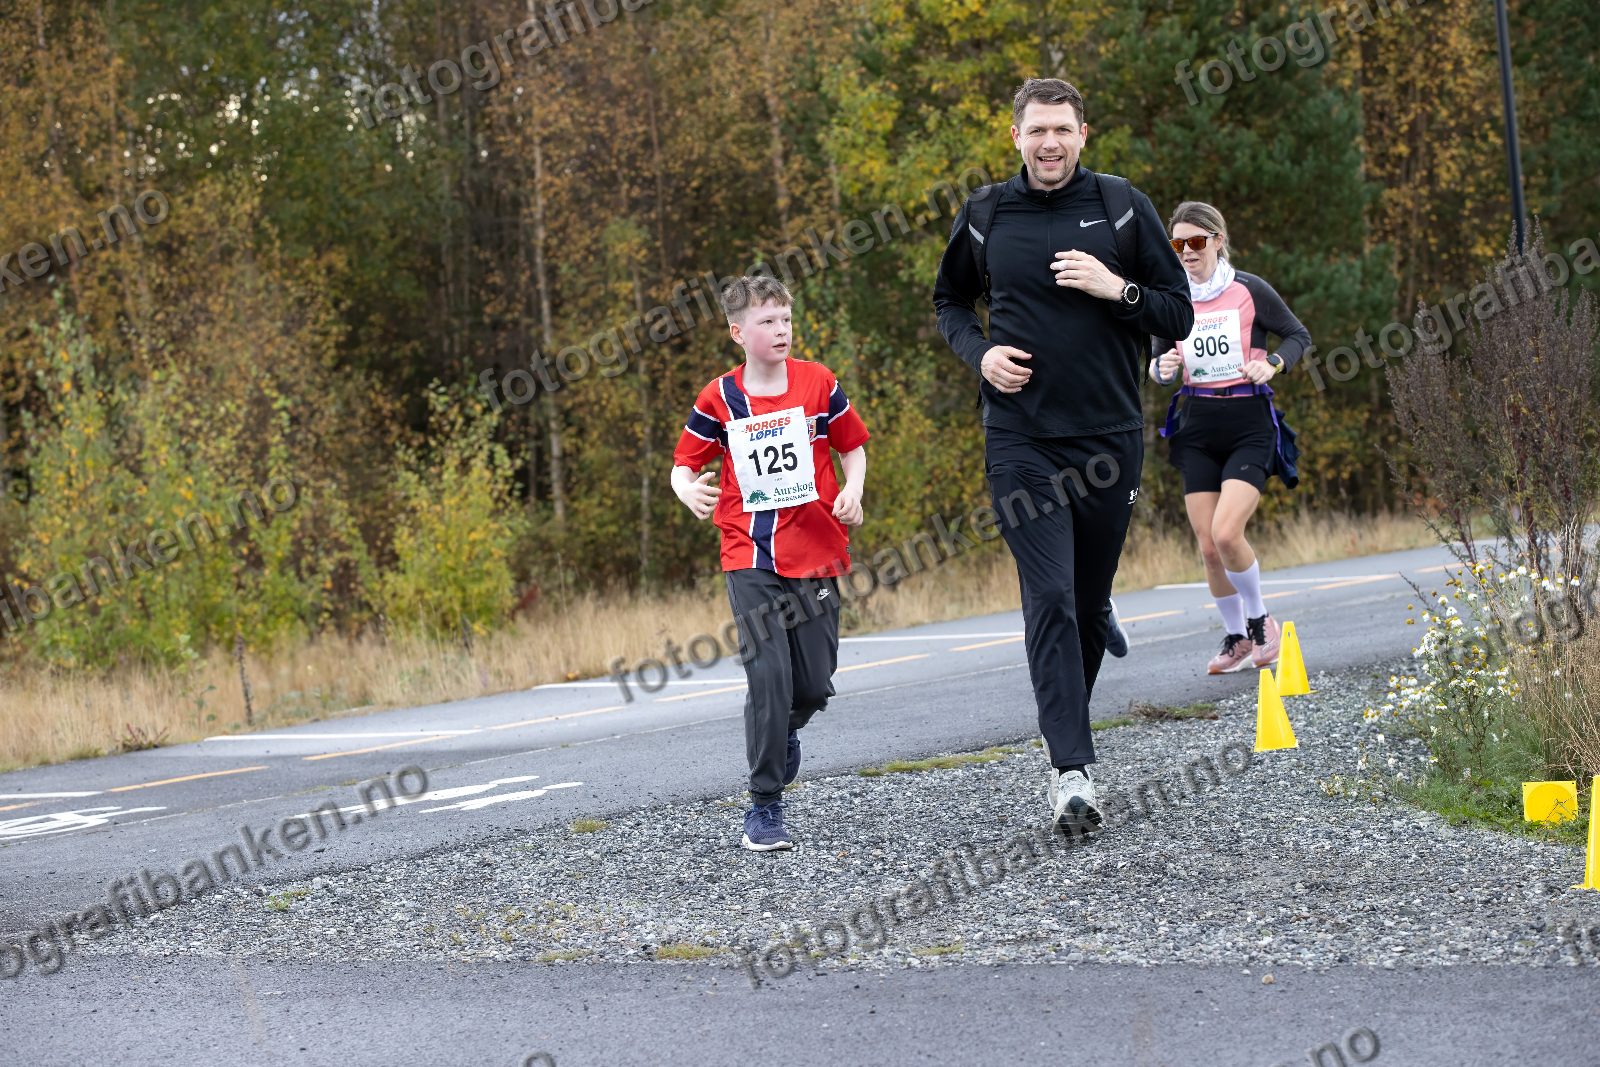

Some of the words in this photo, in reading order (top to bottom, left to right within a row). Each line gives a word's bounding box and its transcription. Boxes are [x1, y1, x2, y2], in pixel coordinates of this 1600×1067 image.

[1194, 315, 1228, 326] NORGES
[1193, 334, 1230, 358] 906
[745, 416, 791, 433] NORGES
[750, 427, 785, 442] LØPET
[748, 442, 798, 477] 125
[774, 481, 814, 496] Aurskog
